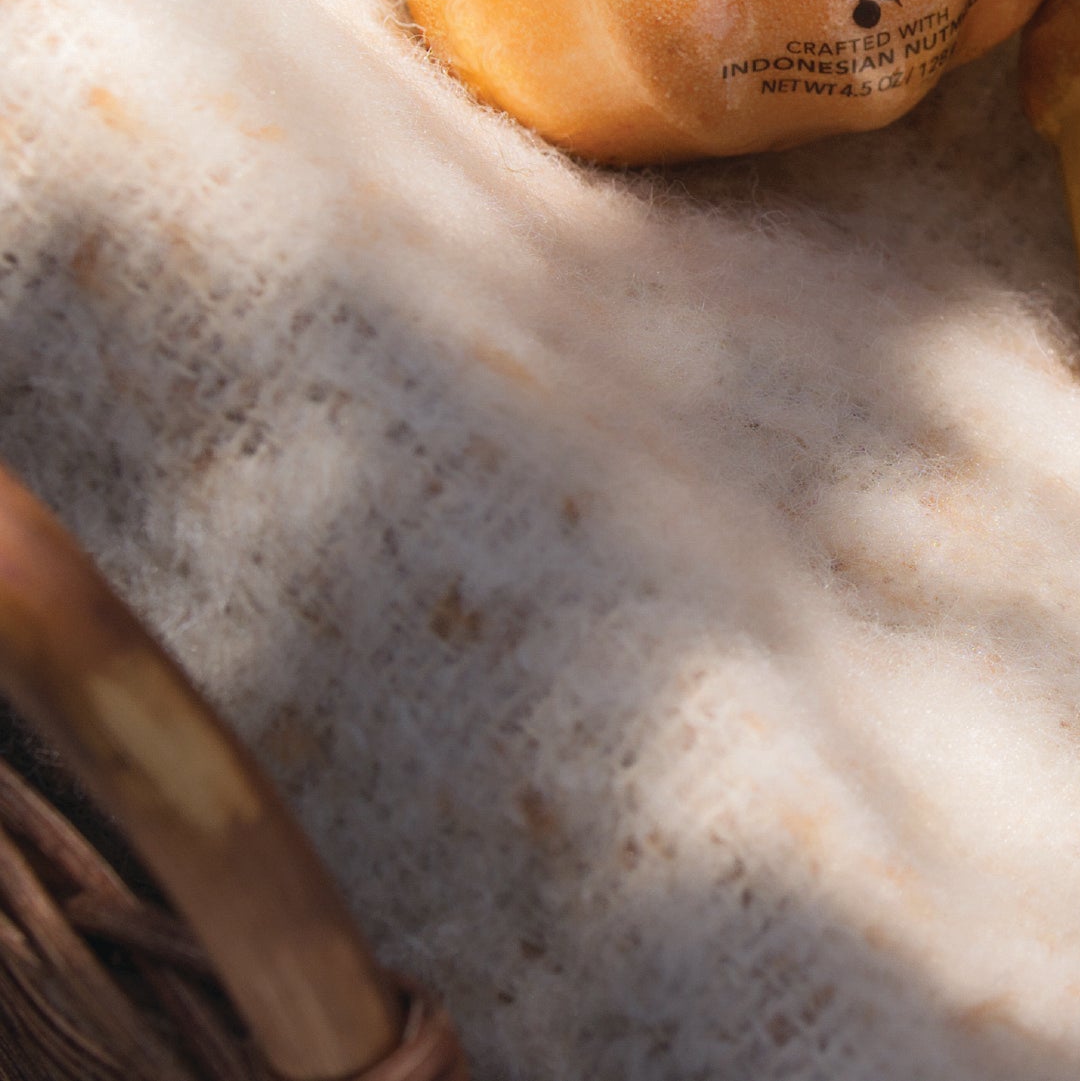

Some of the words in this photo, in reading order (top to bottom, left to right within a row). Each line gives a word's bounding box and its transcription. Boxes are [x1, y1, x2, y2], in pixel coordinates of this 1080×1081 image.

[786, 31, 891, 57] CRAFTED
[898, 6, 949, 40] WITH
[721, 49, 895, 80] INDONESIAN
[761, 78, 800, 95] NET
[805, 80, 838, 96] WT
[840, 80, 873, 97] 4.5
[877, 71, 904, 92] OZ
